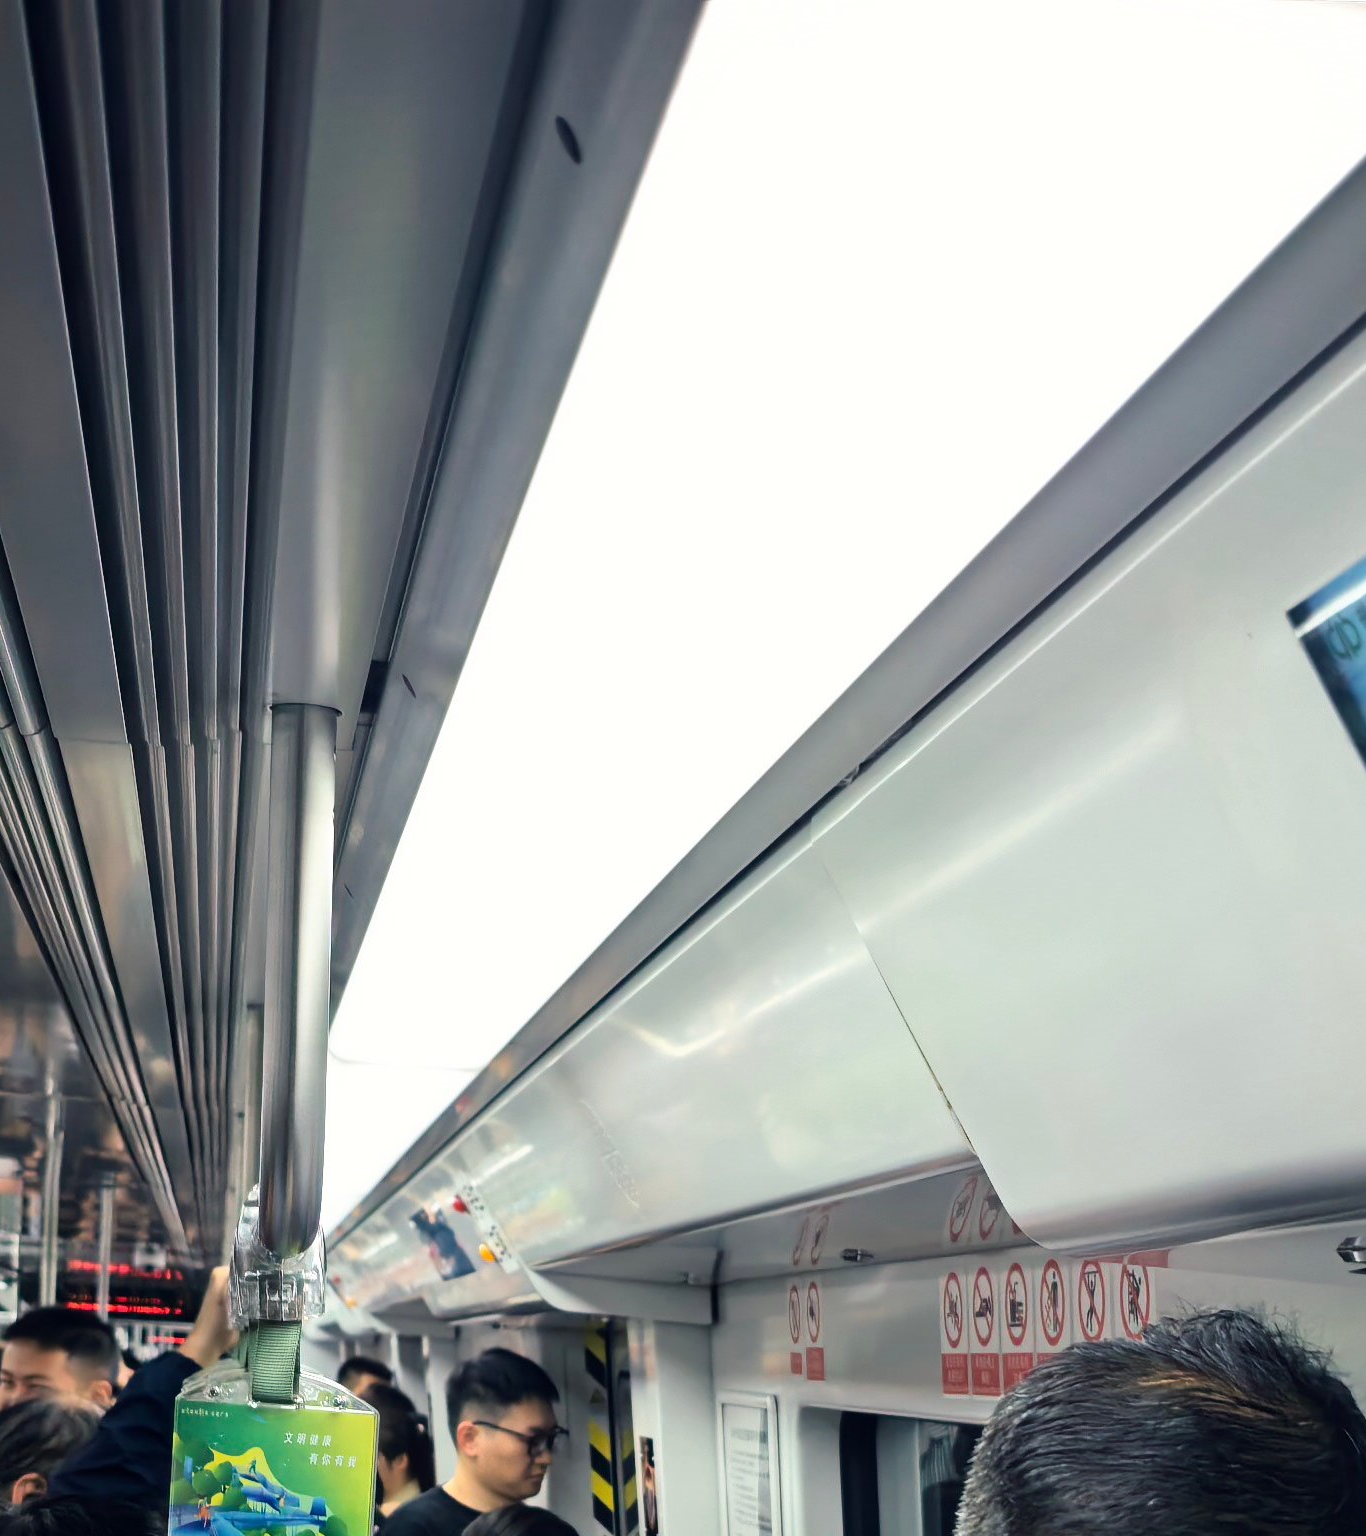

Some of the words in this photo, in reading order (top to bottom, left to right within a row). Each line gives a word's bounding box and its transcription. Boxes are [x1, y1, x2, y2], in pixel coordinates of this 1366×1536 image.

[284, 1432, 332, 1448] 文明健康
[309, 1453, 357, 1468] 有你有我
